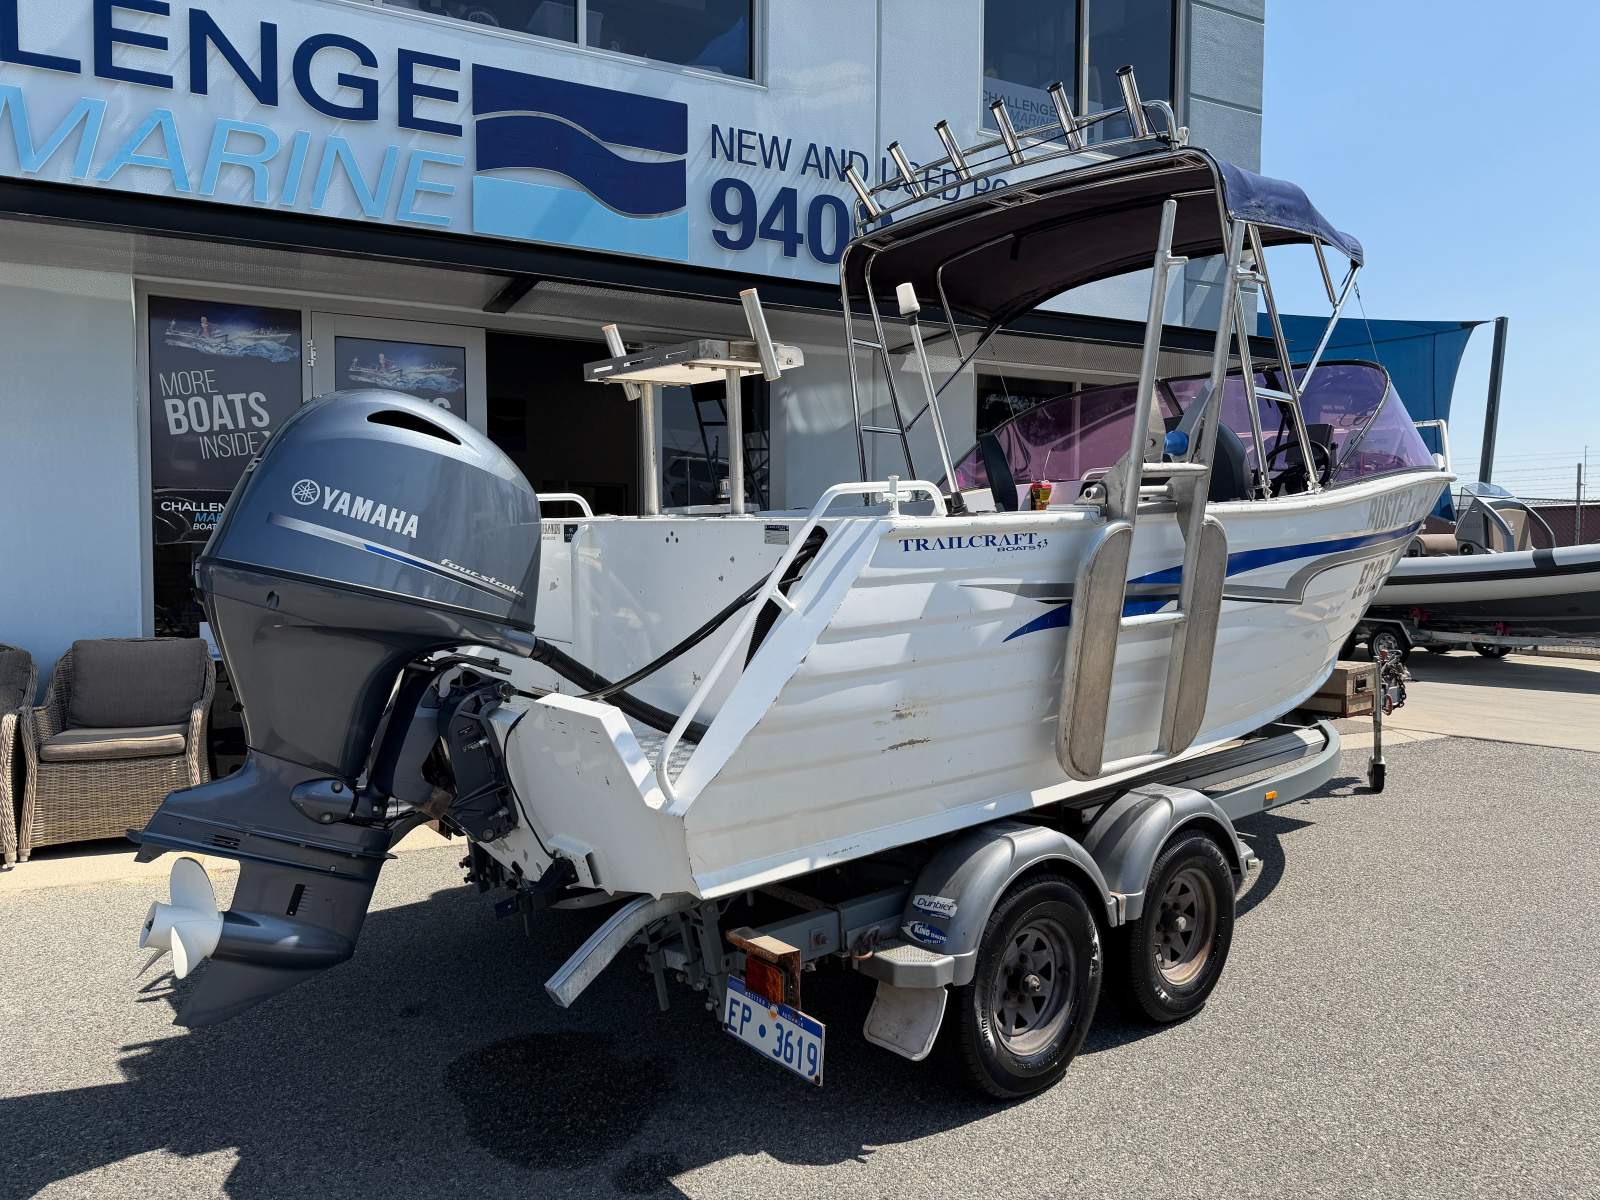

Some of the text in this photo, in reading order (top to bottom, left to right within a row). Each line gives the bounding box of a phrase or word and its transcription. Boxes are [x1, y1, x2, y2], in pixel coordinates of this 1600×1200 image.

[0, 0, 462, 137] LENGE
[0, 84, 465, 226] MARINE
[711, 124, 792, 172] NEW
[801, 143, 869, 184] AND
[710, 177, 893, 265] 940
[159, 369, 219, 396] MORE
[164, 391, 270, 435] BOATS
[199, 431, 259, 460] INSIDE
[322, 486, 419, 539] YAMAHA
[899, 532, 1038, 552] TRAILCRAFT
[917, 897, 954, 911] Dunbier
[728, 997, 818, 1077] EP 3619
